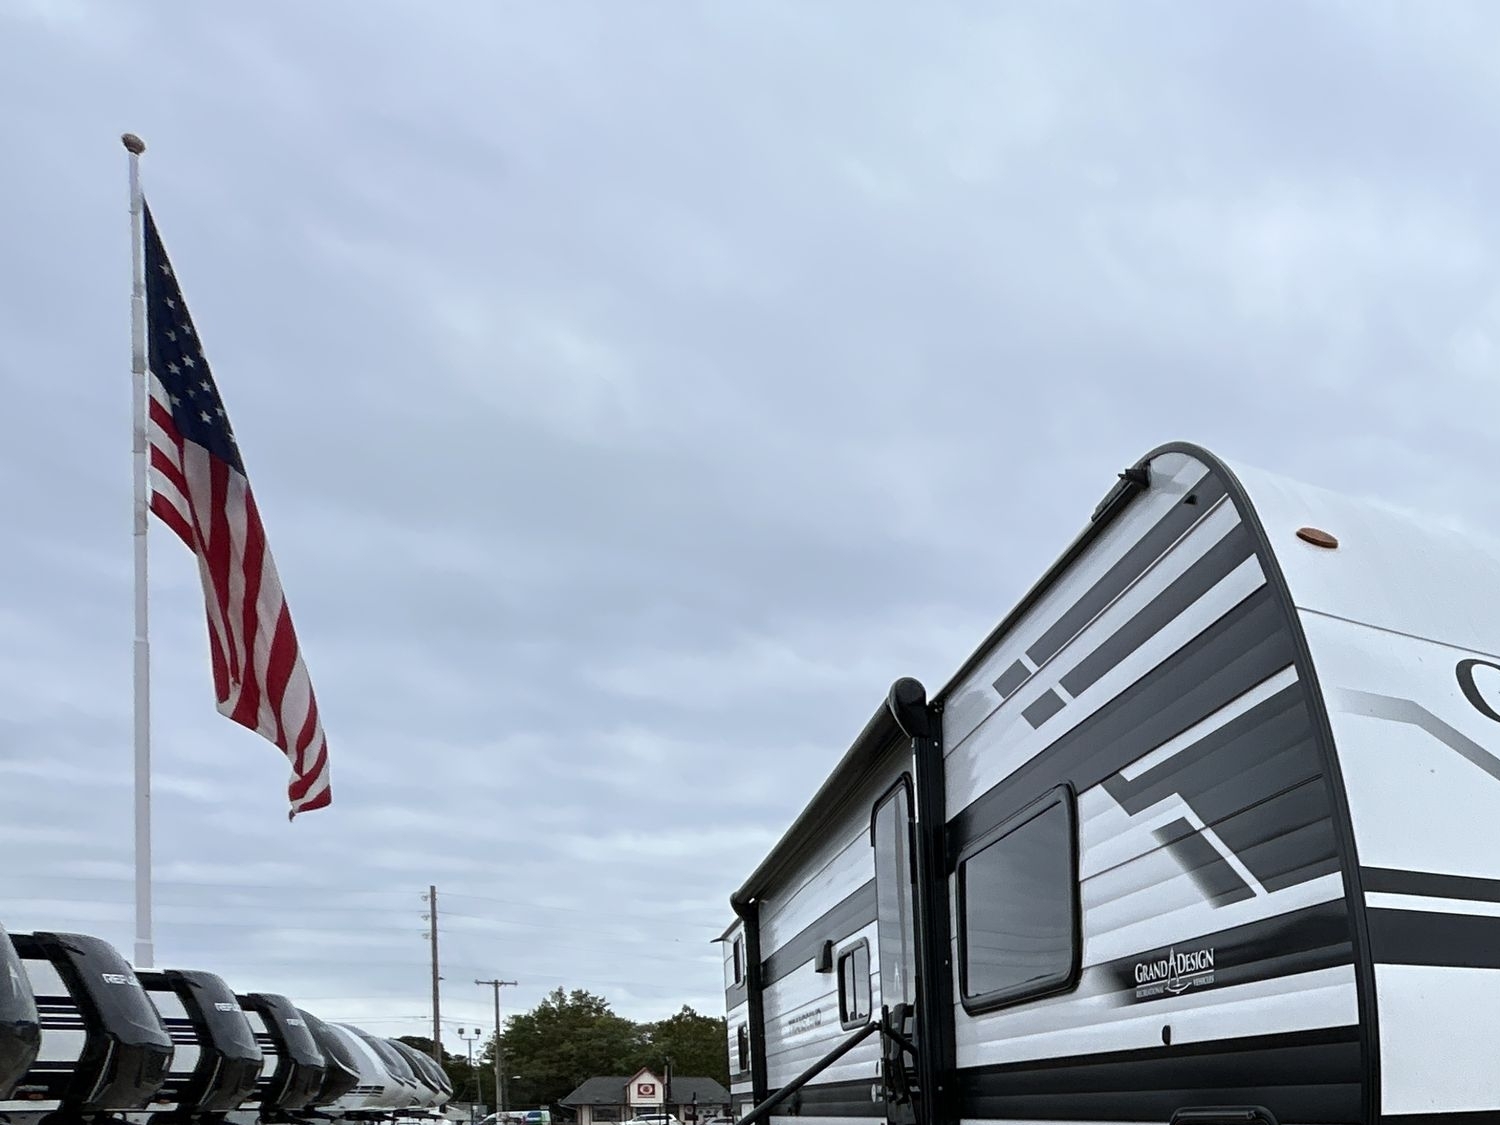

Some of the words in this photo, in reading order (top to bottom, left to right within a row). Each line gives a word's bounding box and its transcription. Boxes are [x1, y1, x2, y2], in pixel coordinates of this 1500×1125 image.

[1135, 960, 1168, 983] GRAND
[1176, 948, 1215, 974] DESIGN
[101, 973, 141, 987] REFL
